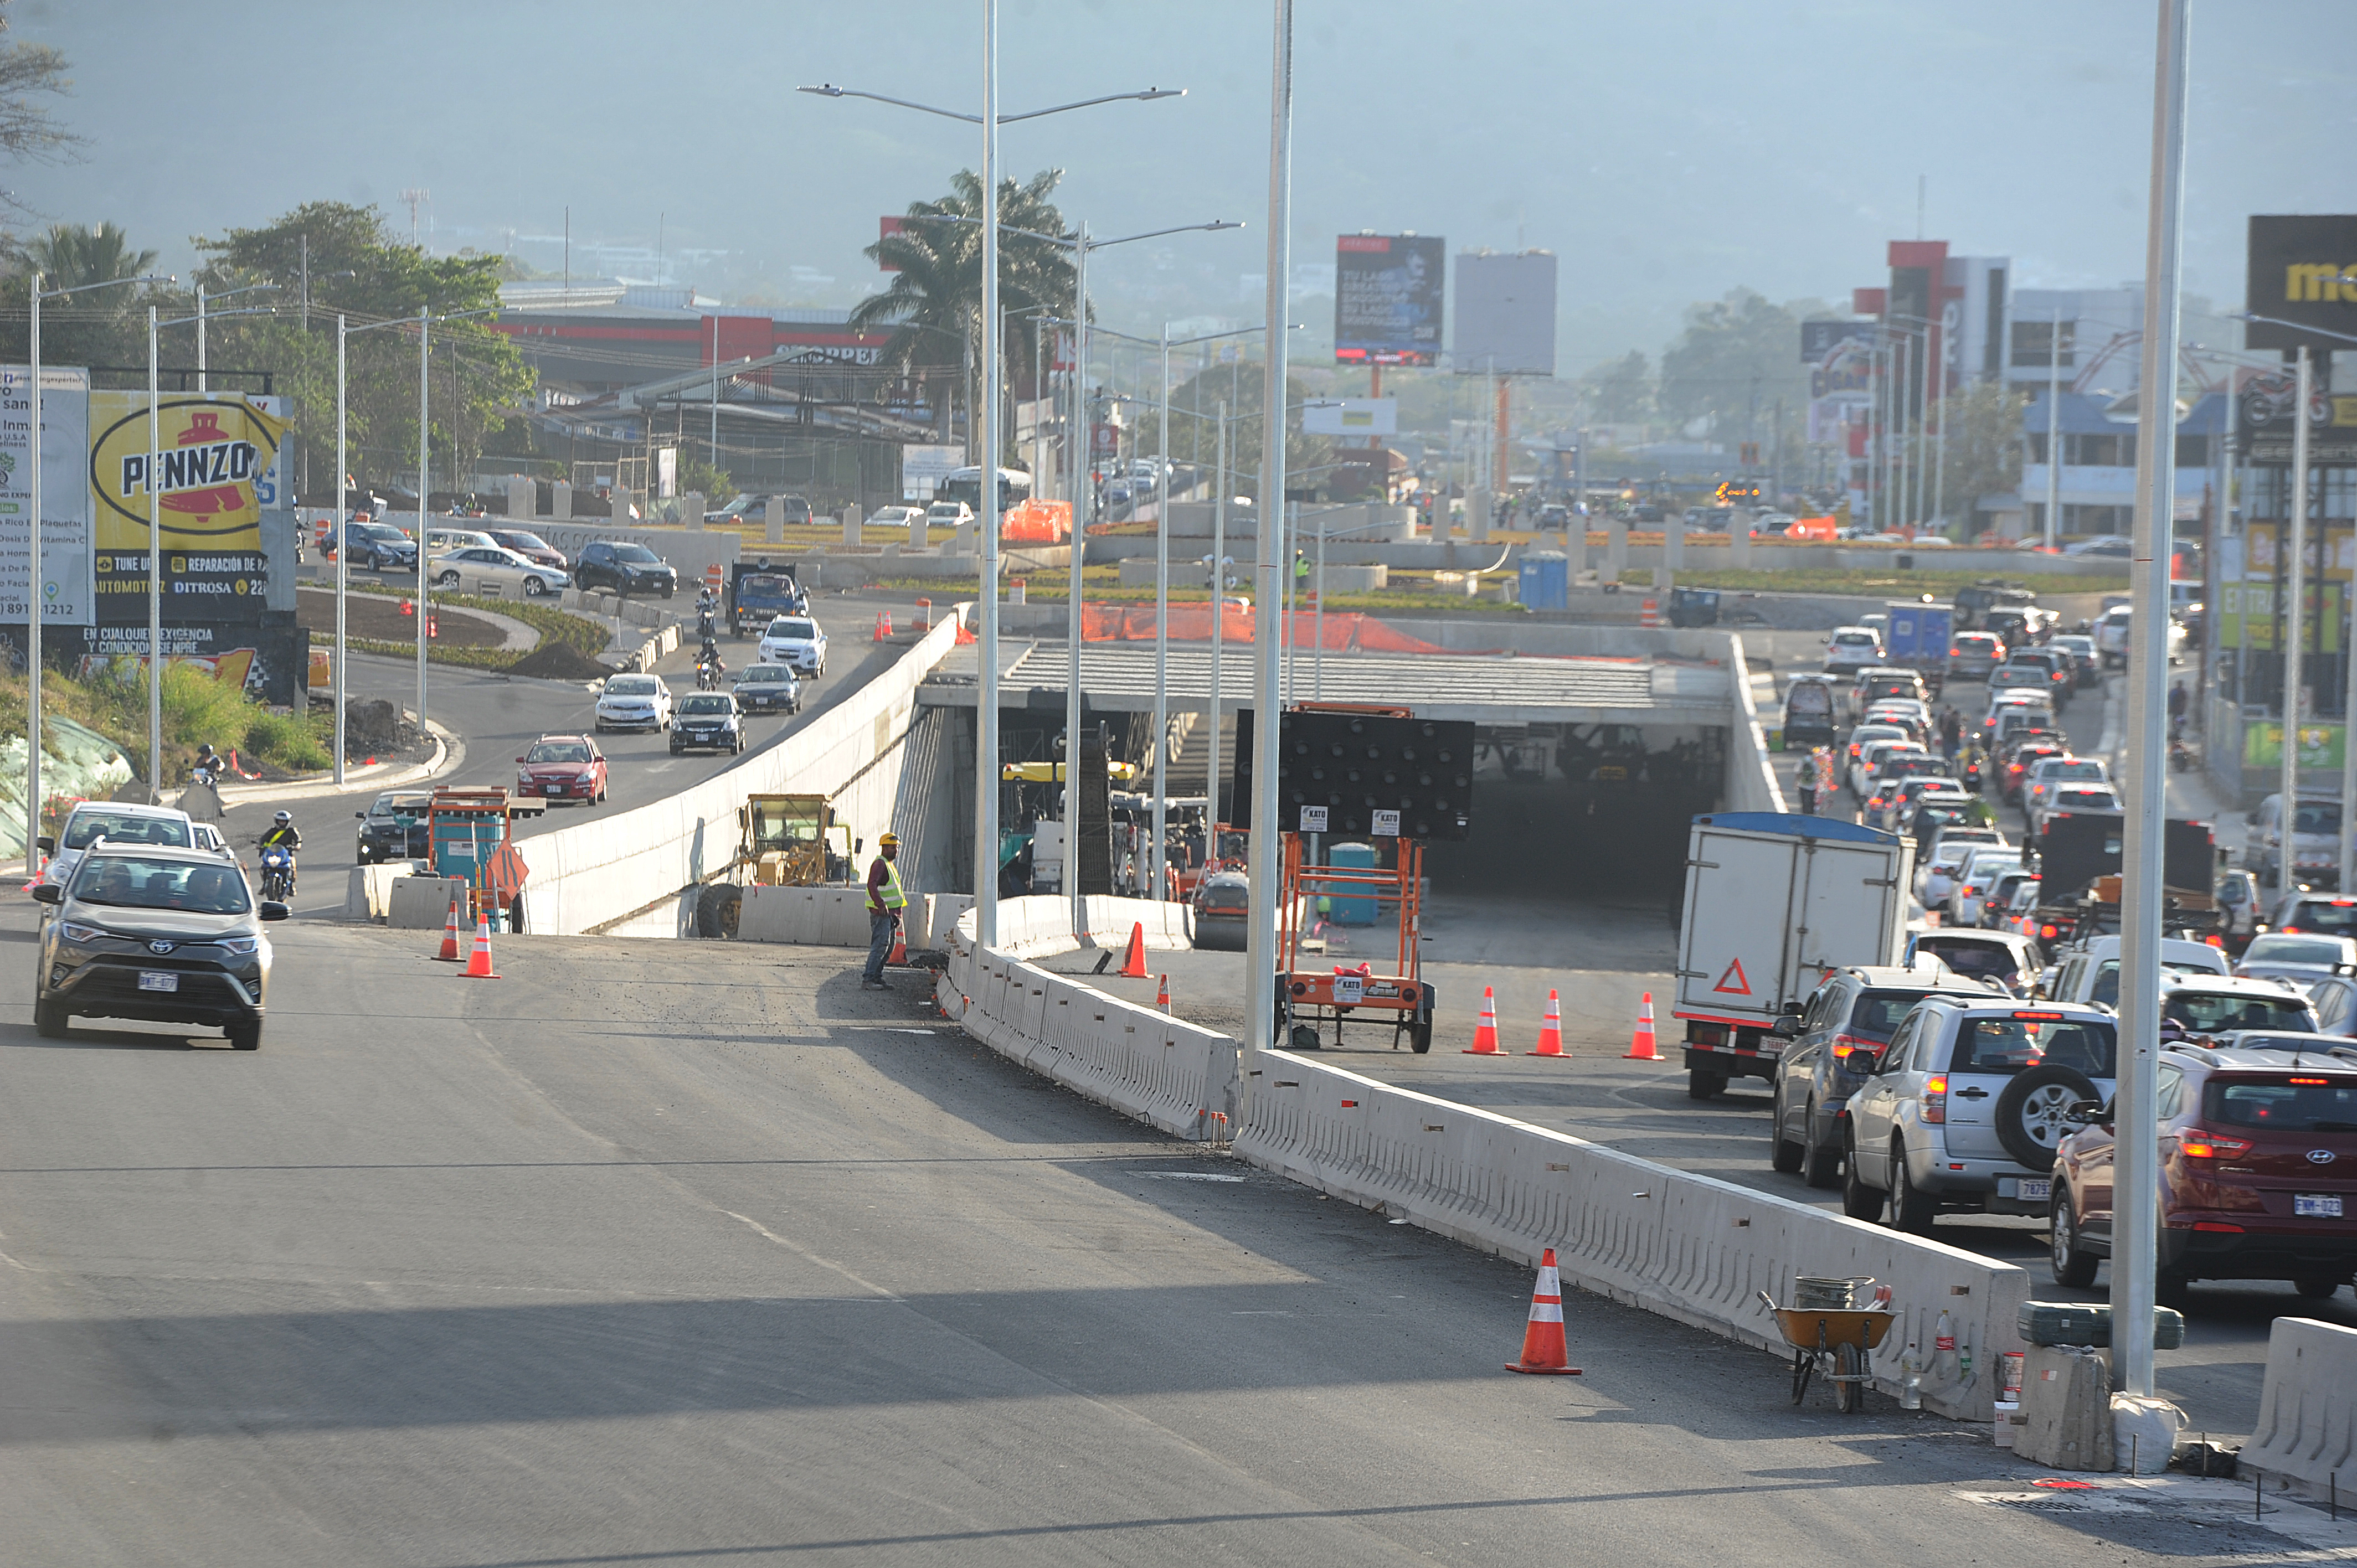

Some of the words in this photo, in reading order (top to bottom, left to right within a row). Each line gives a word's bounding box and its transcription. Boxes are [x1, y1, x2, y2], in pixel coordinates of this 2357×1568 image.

[3, 398, 44, 410] san!
[4, 419, 45, 431] Inmn
[115, 556, 138, 571] TUNE
[188, 555, 243, 572] REPARACIÓN
[244, 557, 255, 571] DE
[95, 580, 166, 594] AUTOMOTZ
[84, 628, 97, 641] EN
[88, 641, 95, 653] Y
[1309, 809, 1326, 818] KATO
[1342, 981, 1360, 989] KATO
